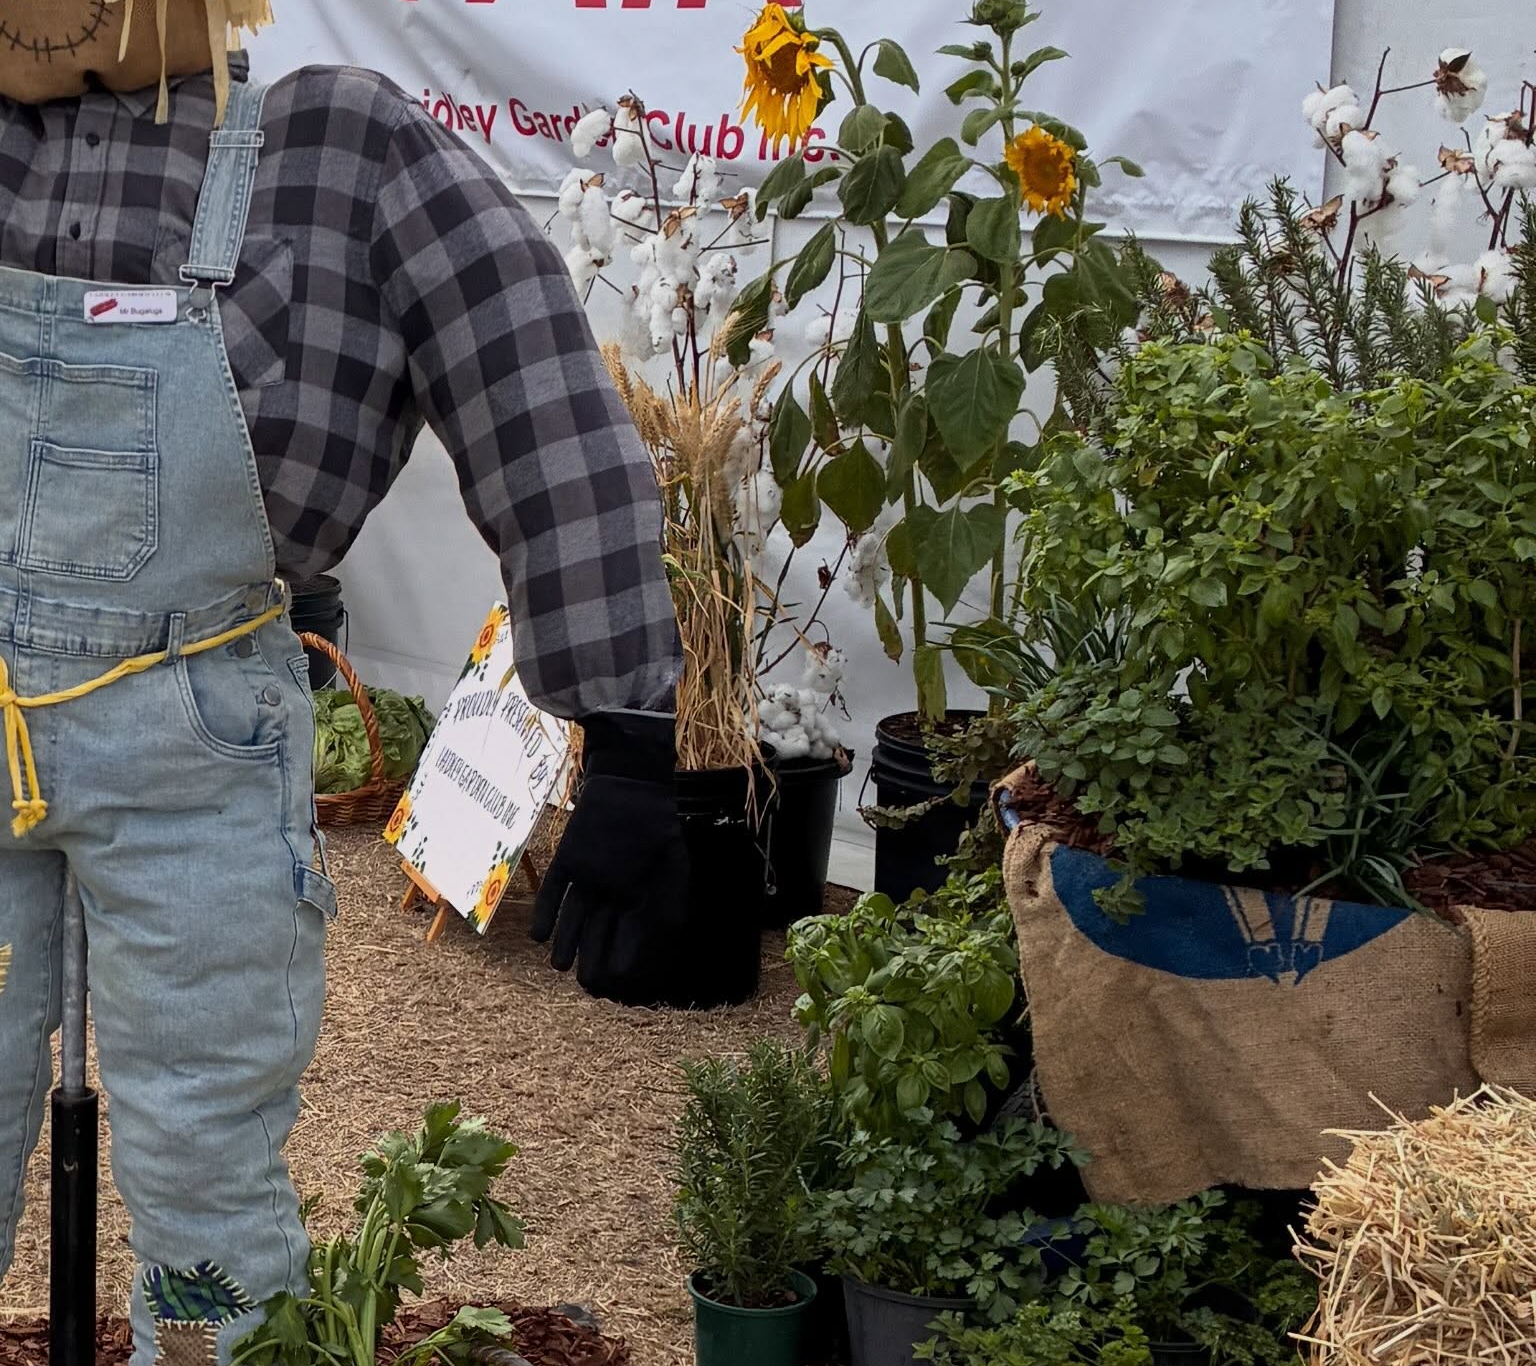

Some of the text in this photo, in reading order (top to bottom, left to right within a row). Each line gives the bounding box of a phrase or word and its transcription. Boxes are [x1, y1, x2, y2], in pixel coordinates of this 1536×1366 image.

[424, 88, 498, 145] idley
[509, 97, 617, 147] Gard
[645, 109, 745, 160] Club
